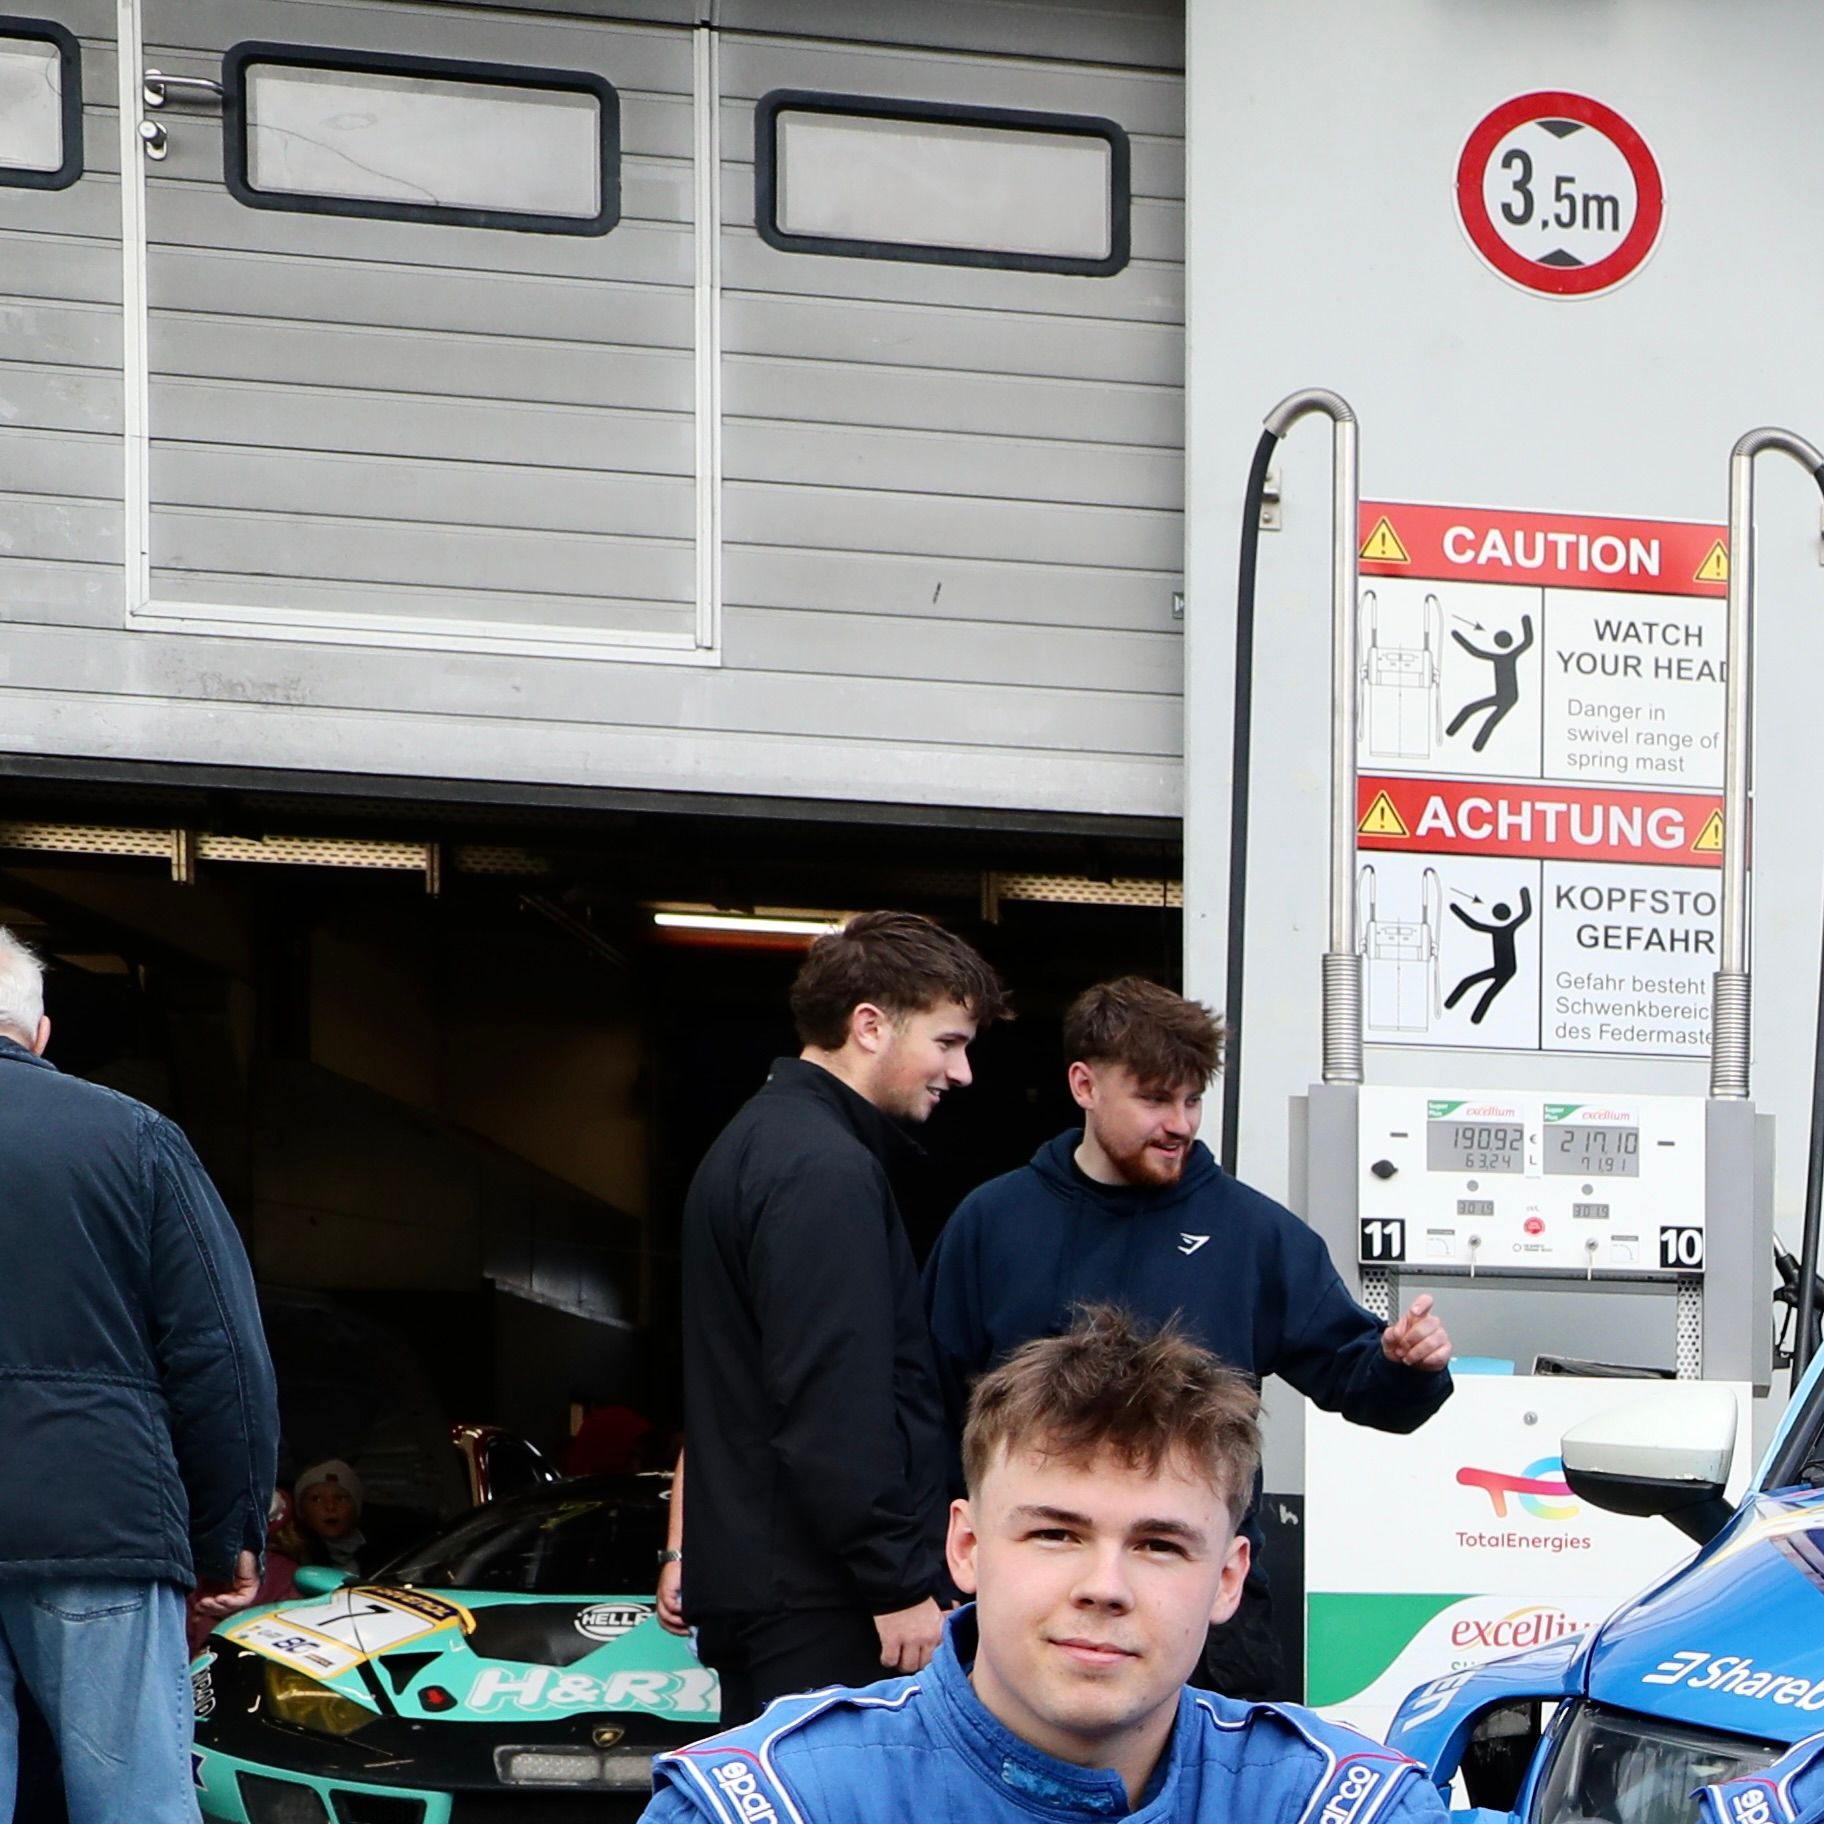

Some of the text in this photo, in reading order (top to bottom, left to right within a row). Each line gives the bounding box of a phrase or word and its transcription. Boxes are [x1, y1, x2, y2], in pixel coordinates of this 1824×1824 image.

[1500, 149, 1621, 232] 3,5m
[1441, 525, 1662, 578] CAUTION
[1594, 618, 1703, 647] WATCH
[1556, 650, 1642, 679] YOUR
[1567, 698, 1666, 725] Danger in
[1567, 725, 1720, 752] swivel range of
[1567, 752, 1686, 773] spring mast
[1415, 794, 1687, 849] ACHTUNG
[1575, 923, 1716, 955] GEFAHR
[1555, 971, 1707, 996] Gefahr besteht
[1555, 1022, 1592, 1042] des
[1363, 1221, 1402, 1260] 11
[1660, 1229, 1703, 1266] 10
[1455, 1532, 1592, 1553] TotalEnergies
[1451, 1613, 1594, 1649] excelli
